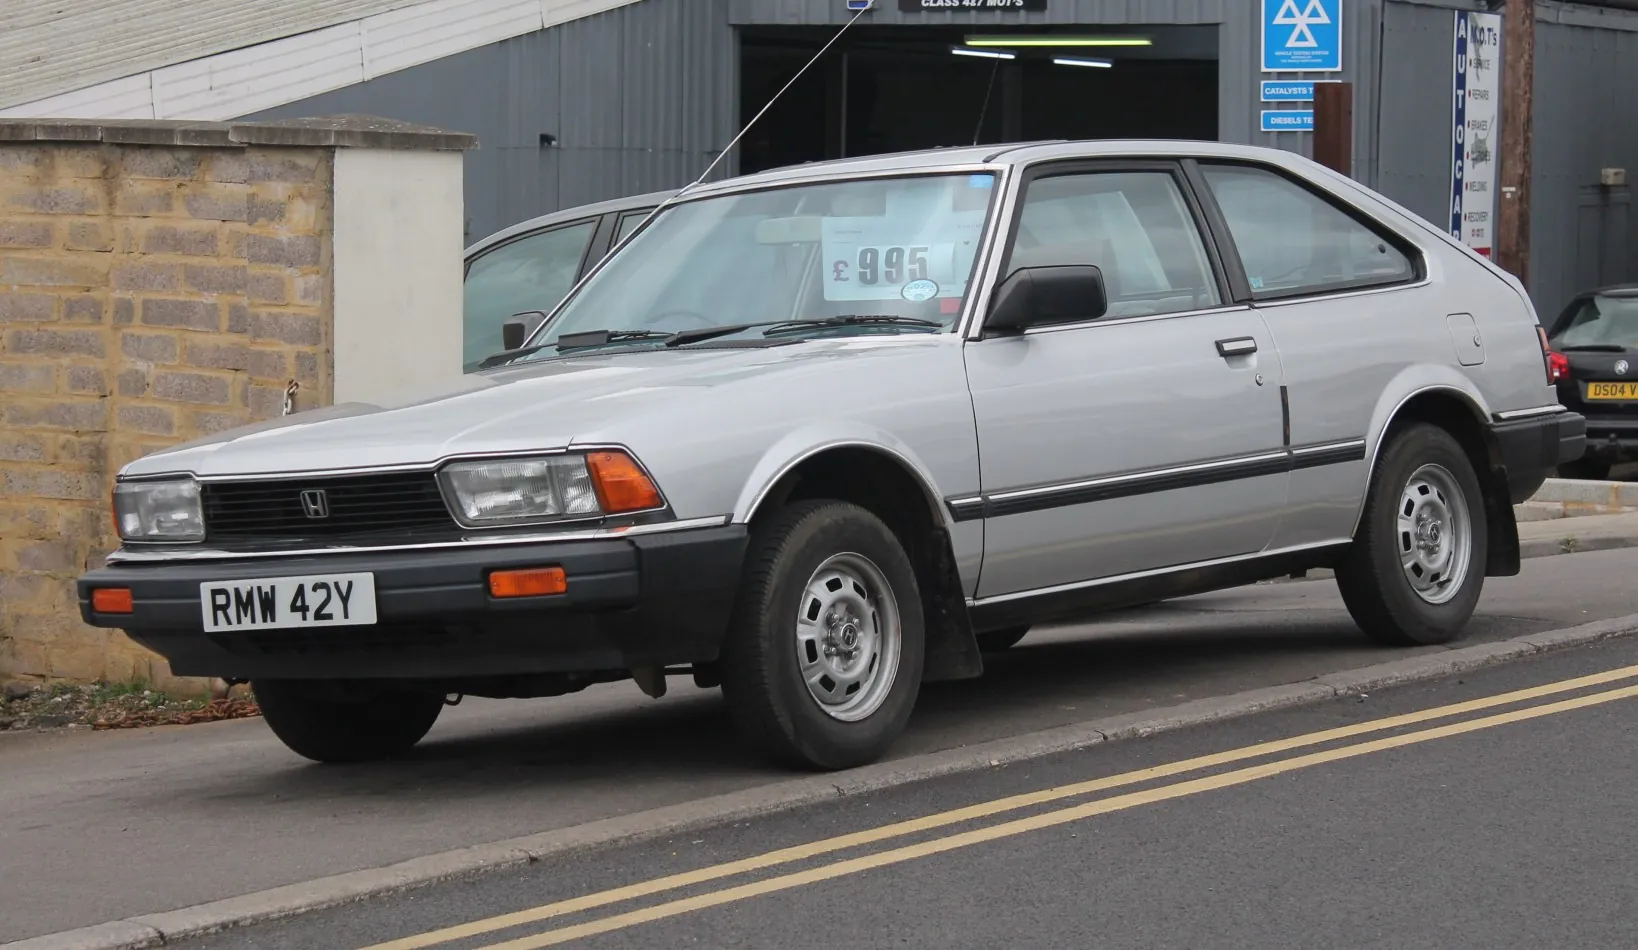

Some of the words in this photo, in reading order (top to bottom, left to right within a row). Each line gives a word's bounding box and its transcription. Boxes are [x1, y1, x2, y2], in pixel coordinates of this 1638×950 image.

[1264, 87, 1307, 95] CATALYSTS
[1270, 117, 1302, 125] DIESELS
[1593, 384, 1625, 397] DS04
[210, 585, 277, 627] RMW
[289, 580, 354, 622] 42Y
